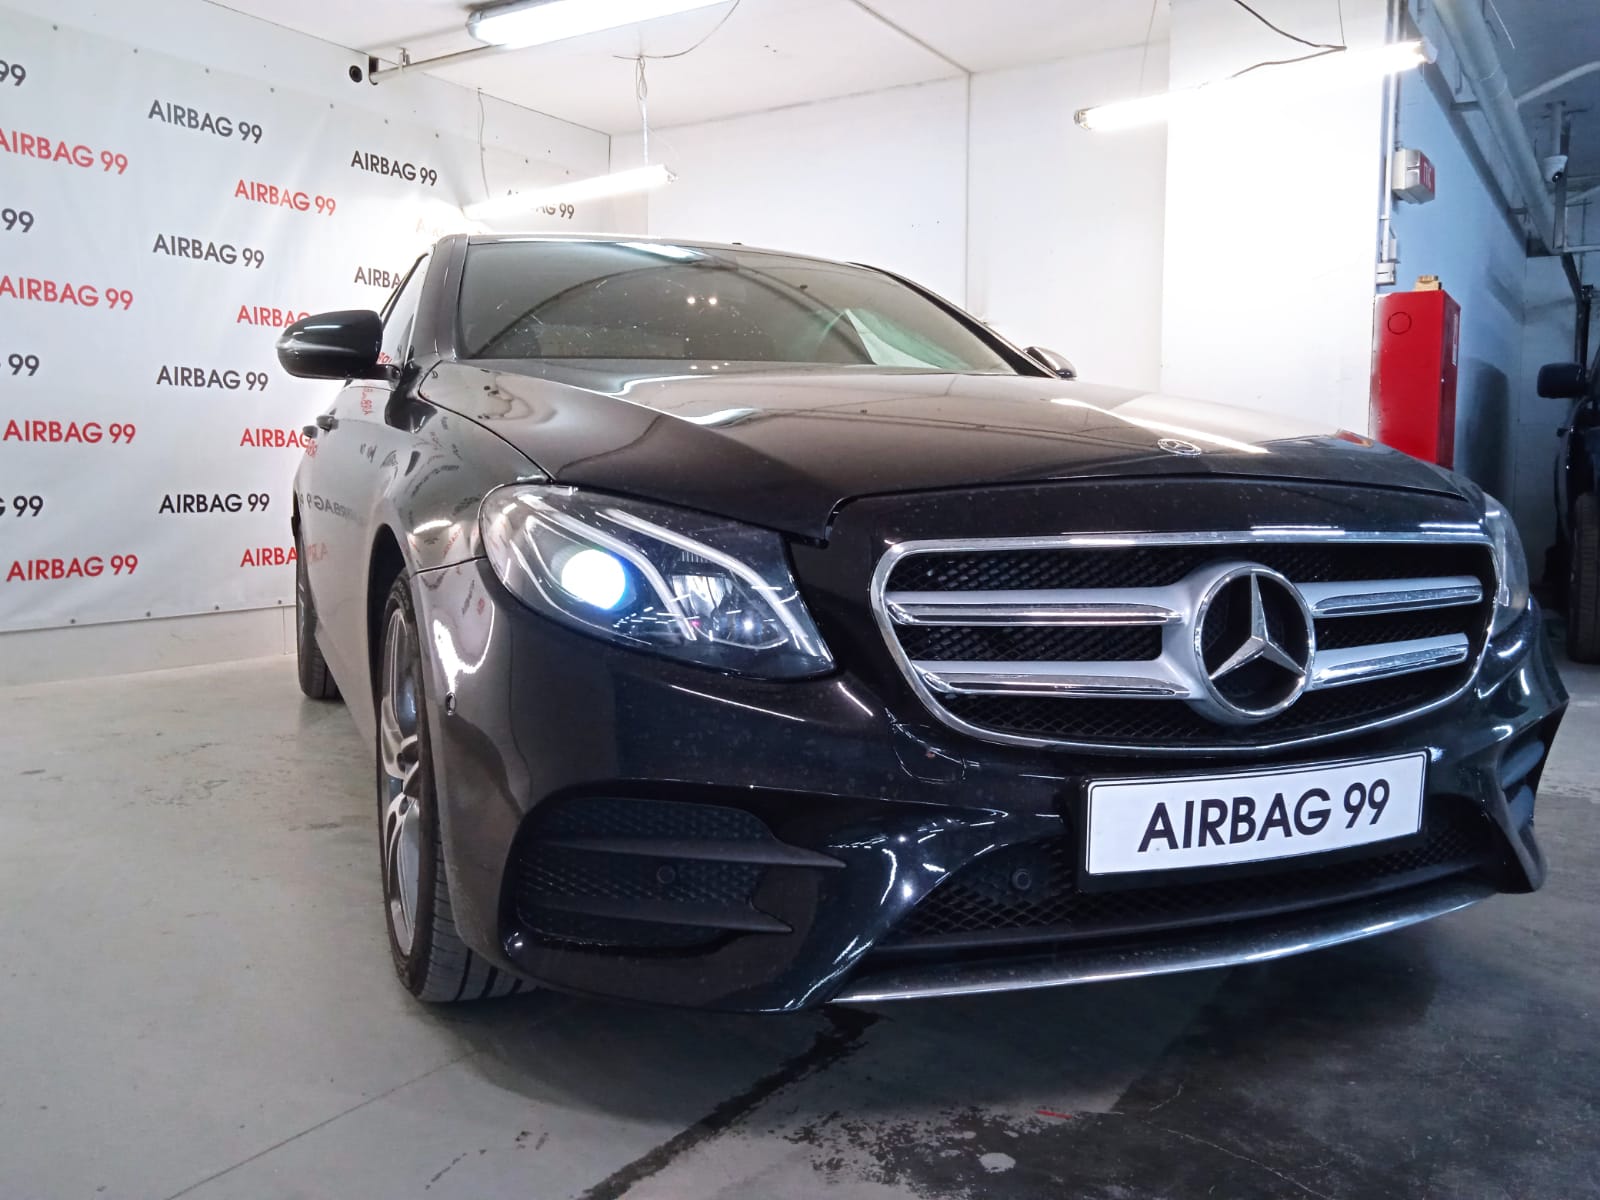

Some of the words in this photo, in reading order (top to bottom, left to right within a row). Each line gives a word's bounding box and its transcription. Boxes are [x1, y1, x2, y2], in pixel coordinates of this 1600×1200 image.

[0, 60, 26, 86] 99
[148, 100, 233, 137] AIRBAG
[238, 122, 262, 144] 99
[0, 128, 94, 167] AIRBAG
[100, 151, 128, 175] 99
[351, 150, 416, 181] AIRBAG
[420, 167, 437, 186] 99
[235, 179, 310, 211] AIRBAG
[315, 195, 336, 215] 99
[1, 208, 34, 232] 99
[559, 203, 575, 219] 99
[153, 234, 237, 264] AIRBAG
[242, 248, 264, 268] 99
[354, 266, 401, 289] AIRBA
[0, 275, 99, 306] AIRBAG
[105, 288, 133, 310] 99
[8, 353, 40, 376] 99
[156, 365, 240, 389] AIRBAG
[246, 372, 268, 391] 99
[3, 420, 103, 443] AIRBAG
[109, 423, 136, 443] 99
[13, 496, 43, 517] 99
[158, 494, 242, 514] AIRBAG
[248, 493, 270, 512] 99
[7, 555, 104, 581] AIRBAG
[110, 554, 138, 574] 99
[240, 546, 298, 567] AIRBA
[1137, 788, 1331, 852] AIRBAG
[1344, 778, 1390, 829] 99
